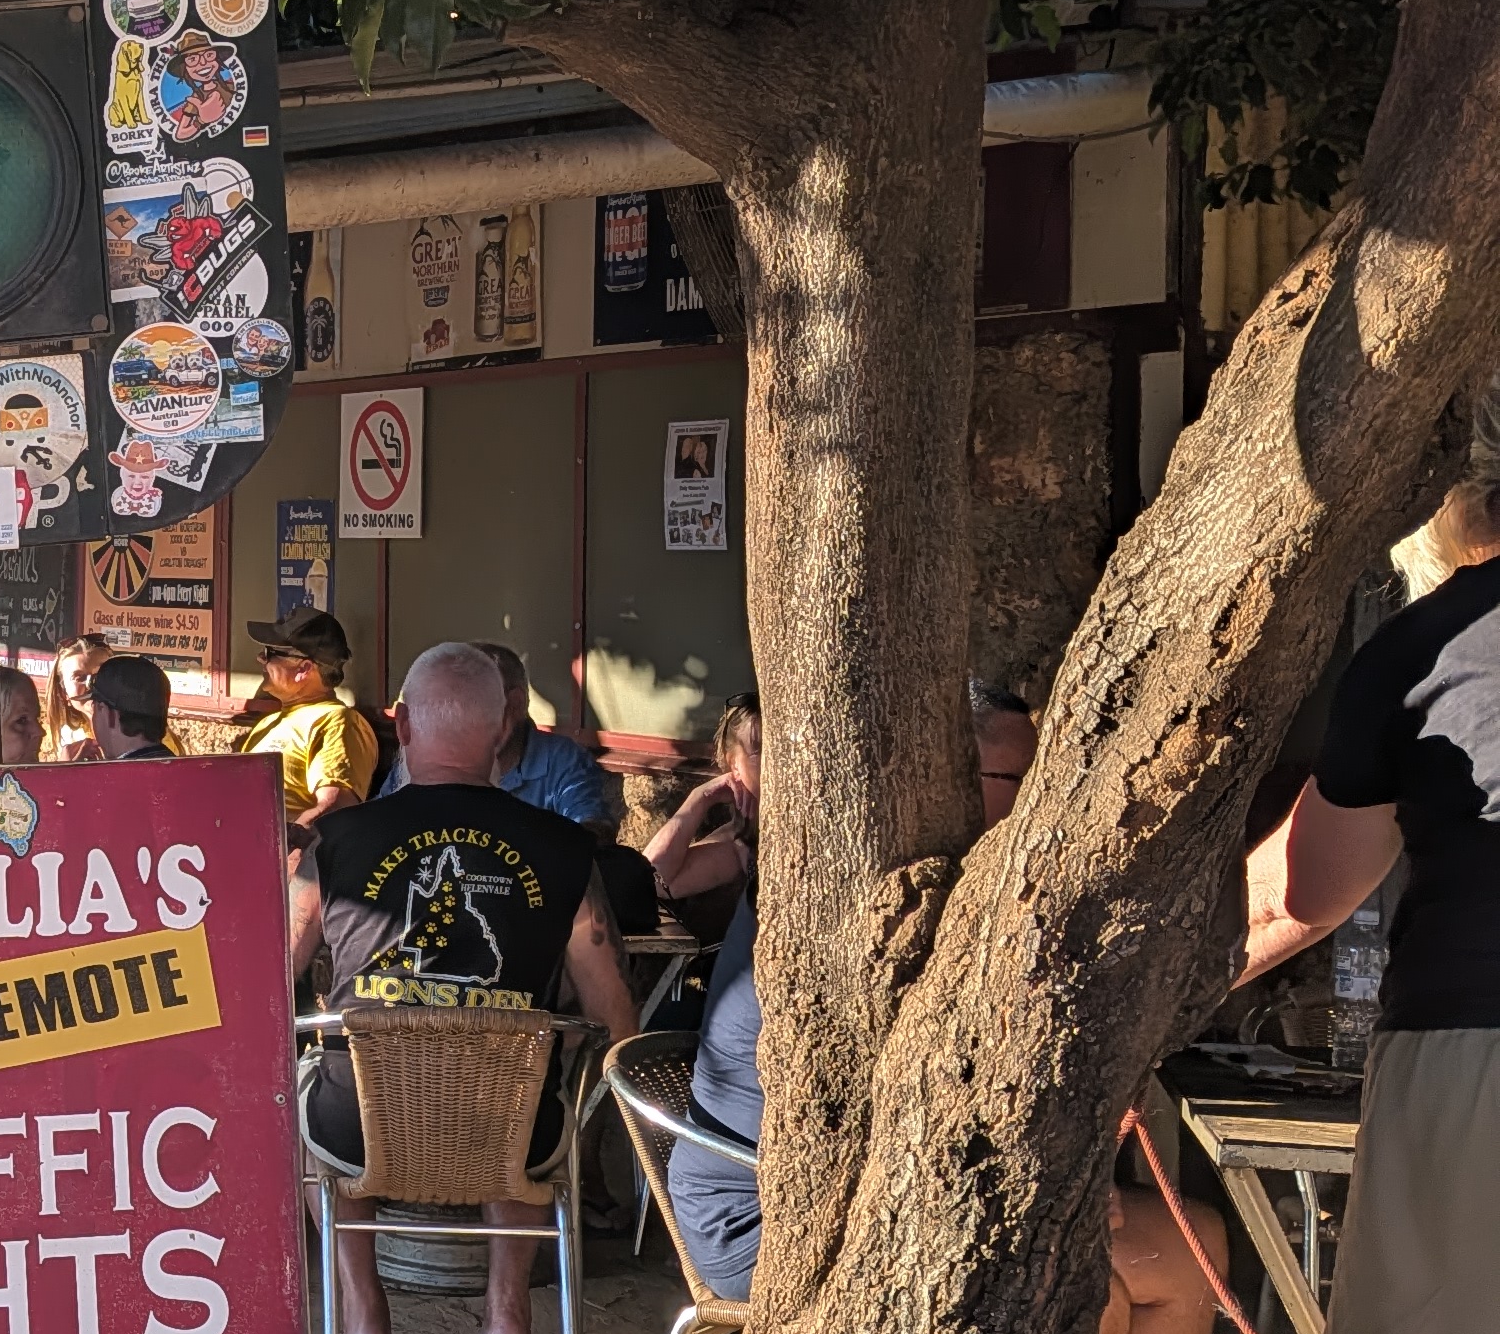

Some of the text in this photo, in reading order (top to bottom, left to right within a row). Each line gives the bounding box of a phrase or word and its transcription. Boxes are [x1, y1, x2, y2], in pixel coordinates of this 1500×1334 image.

[199, 1, 233, 34] THROUGH
[149, 53, 176, 133] LAURA THE
[208, 59, 246, 136] EXPLORER
[111, 129, 154, 143] BORKY
[412, 236, 461, 264] GREAT
[209, 248, 255, 300] PEST CONTROL
[413, 259, 460, 278] NORTHERN
[666, 277, 703, 312] DAM
[129, 394, 213, 416] AdVANture
[151, 410, 190, 422] Australia
[343, 512, 414, 529] NO SMOKING
[184, 534, 198, 544] GOLD
[294, 525, 328, 542] ALCOHOLIC
[280, 543, 331, 560] LEMON SQUASH
[177, 584, 192, 605] Every
[193, 584, 209, 605] Night
[93, 610, 200, 630] Glass of House wine $4.50
[363, 827, 544, 909] MAKE TRACKS TO THE
[460, 883, 511, 895] HELENVALE
[466, 874, 513, 885] COOKTOWN
[353, 974, 534, 1011] LIONS DEN
